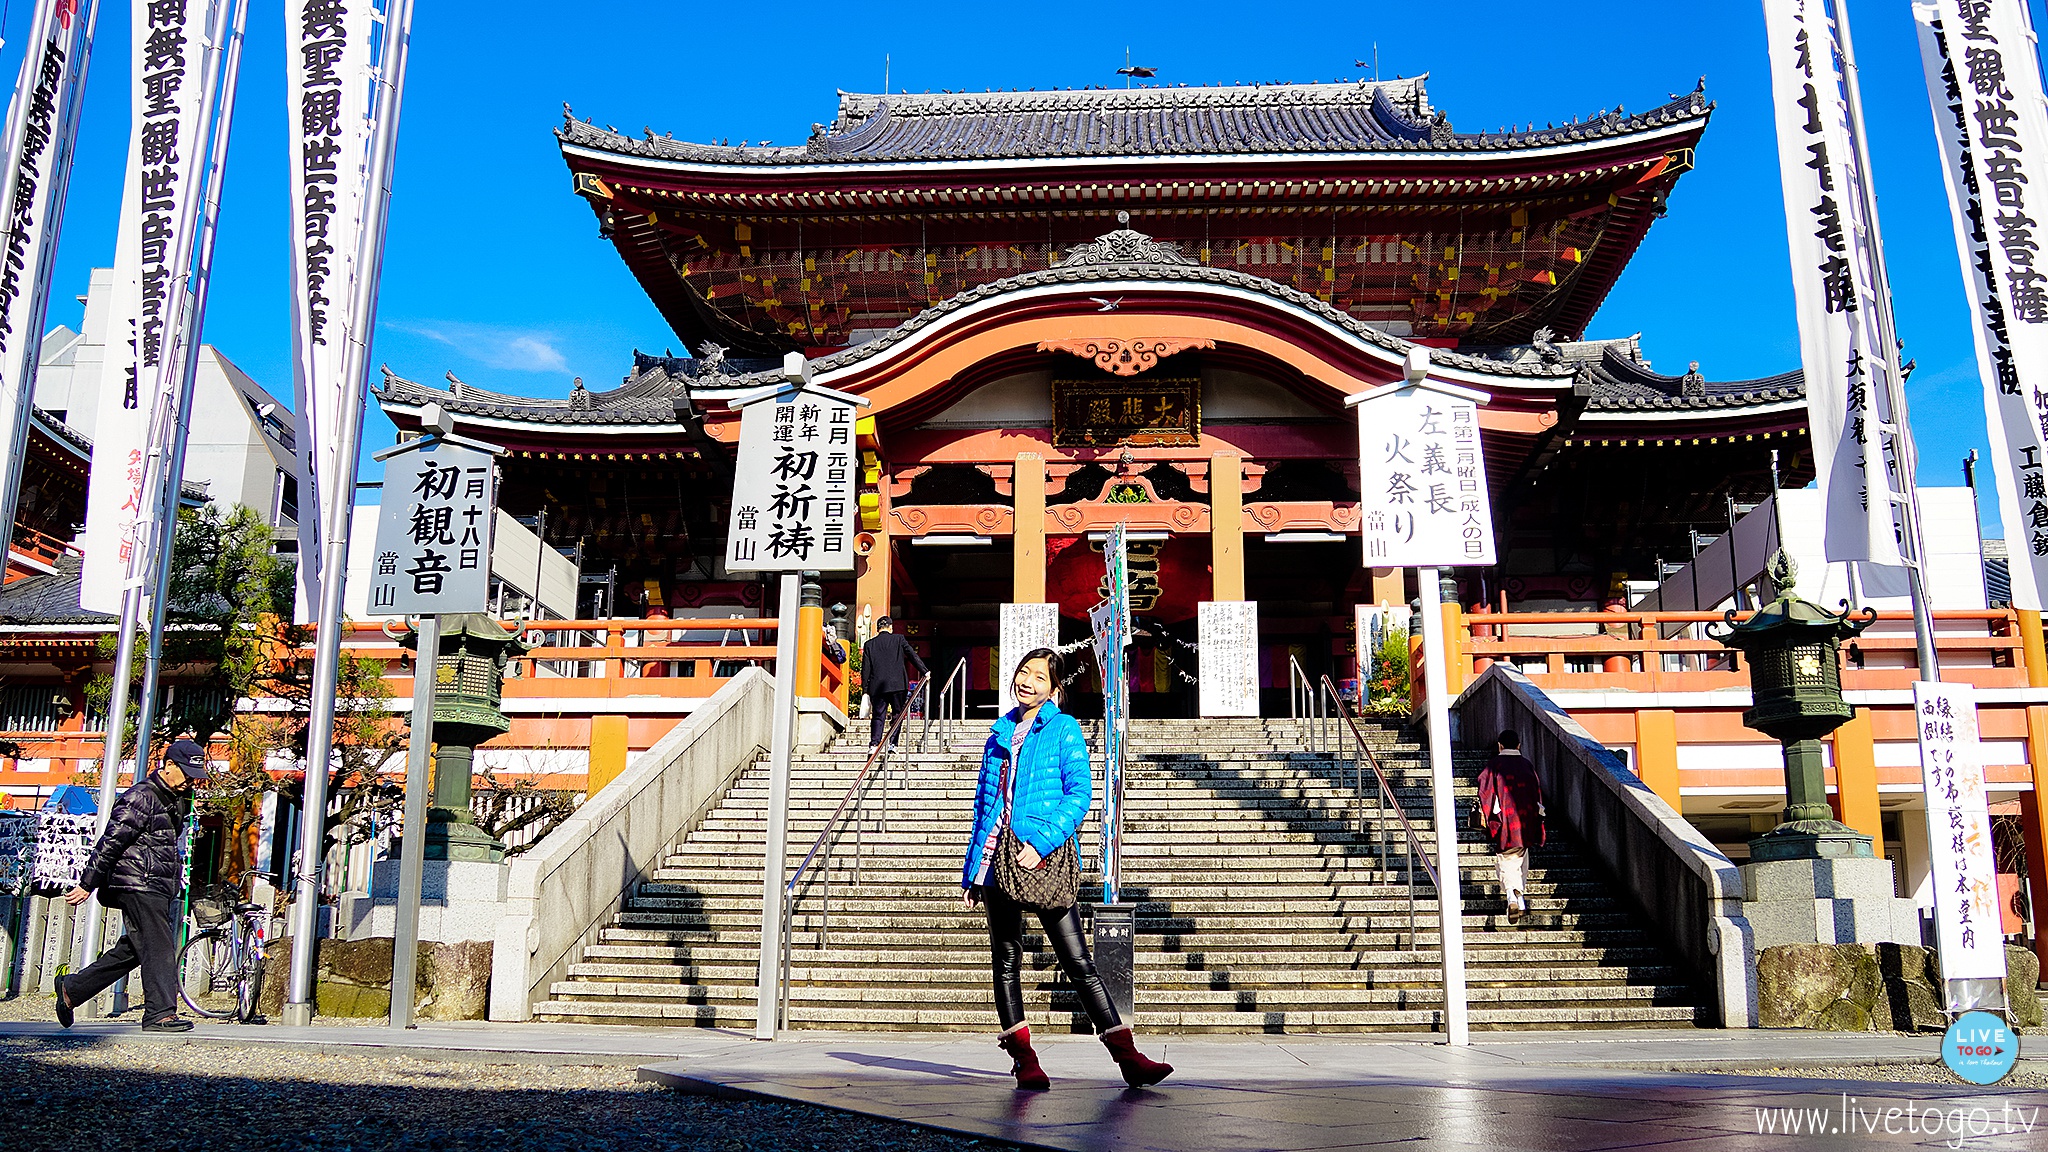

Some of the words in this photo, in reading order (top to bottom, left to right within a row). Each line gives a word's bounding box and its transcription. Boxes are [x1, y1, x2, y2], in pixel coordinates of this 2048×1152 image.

[772, 405, 795, 442] 開運
[797, 403, 821, 441] 新年
[1418, 405, 1457, 515] 左義長
[405, 459, 462, 595] 初観音
[459, 467, 487, 570] 一月十八日
[1385, 433, 1418, 544] 火祭り
[735, 505, 759, 562] 當山
[374, 551, 399, 607] 當山
